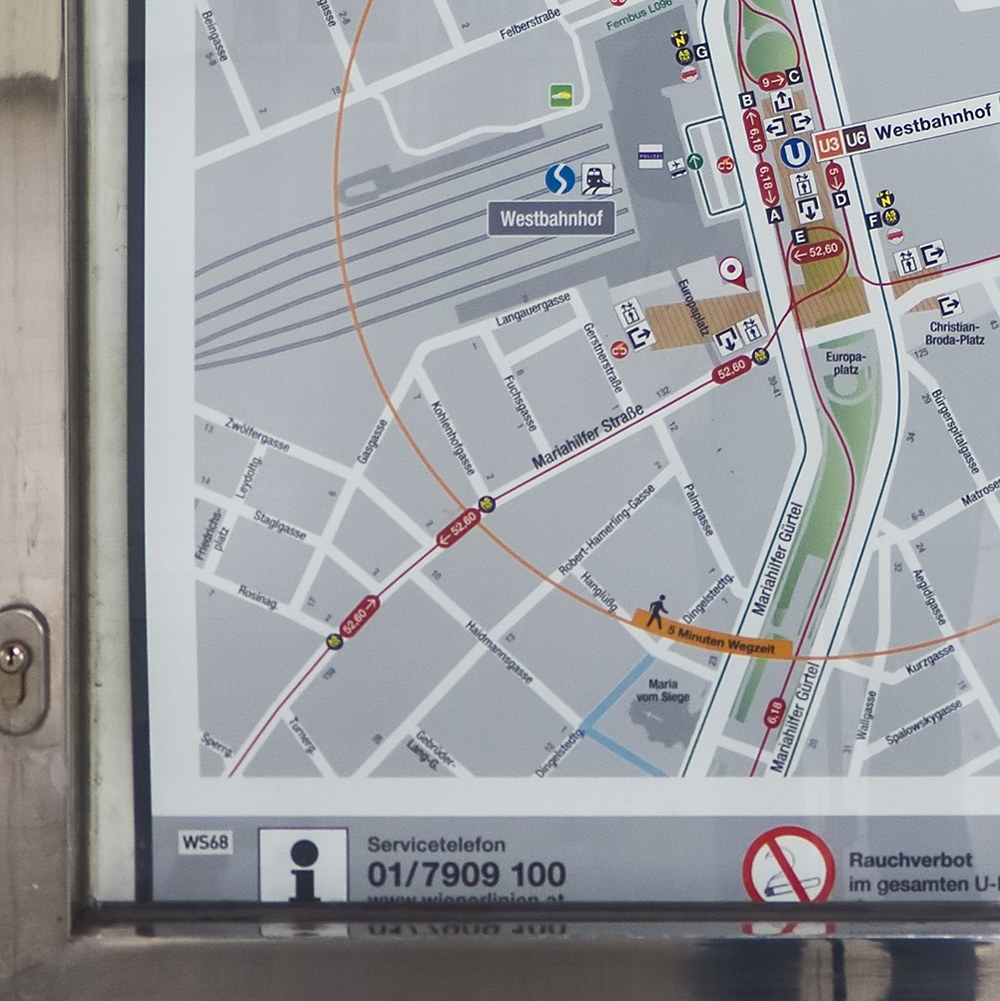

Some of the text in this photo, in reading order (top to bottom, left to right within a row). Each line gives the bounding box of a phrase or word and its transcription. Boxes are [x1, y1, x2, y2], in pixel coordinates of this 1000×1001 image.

[202, 10, 228, 62] Beingasse
[499, 7, 562, 40] Felberstraße
[606, 7, 647, 32] Fernbus
[789, 71, 800, 82] C
[742, 94, 753, 106] B
[750, 130, 763, 150] 6,18
[819, 102, 992, 153] U3 U6 Westbahnhof
[759, 166, 773, 190] 6,18
[501, 210, 604, 228] Westbahnhof
[809, 243, 838, 257] 52,60
[495, 292, 571, 327] Langauergasse
[679, 279, 709, 338] Europaplatz
[925, 334, 985, 346] Broda-Platz
[930, 321, 980, 332] Christian-
[583, 323, 623, 393] Gerstnerstraße
[718, 360, 746, 379] 52,60
[826, 351, 866, 363] Europa-
[834, 364, 858, 376] platz
[503, 375, 538, 433] Fuchsgasse
[225, 417, 290, 453] Zwölfergasse
[358, 418, 388, 465] Gasgasse
[431, 401, 475, 476] Kohlenhofgasse
[532, 403, 645, 471] Mariahilfer Straße
[932, 388, 980, 475] Bürgerspitalgasse
[236, 456, 262, 499] Leydoltg.
[253, 510, 307, 541] Staglgasse
[451, 512, 477, 536] 52,60
[684, 483, 714, 538] Palmgasse
[195, 508, 222, 561] Friedrichs-
[214, 527, 230, 552] platz
[558, 483, 656, 577] Robert-Hamerling-Gasse
[751, 502, 803, 617] Mariahilfer Gürtel
[581, 571, 619, 615] Hanglüßg.
[682, 572, 735, 625] Dingelstedtg.
[912, 569, 947, 626] Aegidigasse
[343, 608, 368, 635] 52,60
[465, 619, 534, 684] Haidmannsgasse
[668, 626, 775, 655] 5 Minuten Wegzeit
[905, 644, 955, 676] Kurzgasse
[649, 679, 678, 690] Maria
[770, 662, 820, 773] Mariahilfer Gürtel
[855, 690, 877, 741] Wallgasse
[885, 699, 963, 746] Spalowskygasse
[535, 728, 586, 779] Dingelstedtg.
[182, 836, 229, 850] WS68
[368, 836, 506, 852] Servicetelefon
[368, 861, 567, 888] 01/7909 100
[850, 852, 973, 869] Rauchverbot
[849, 876, 871, 891] im
[878, 877, 969, 894] gesamten
